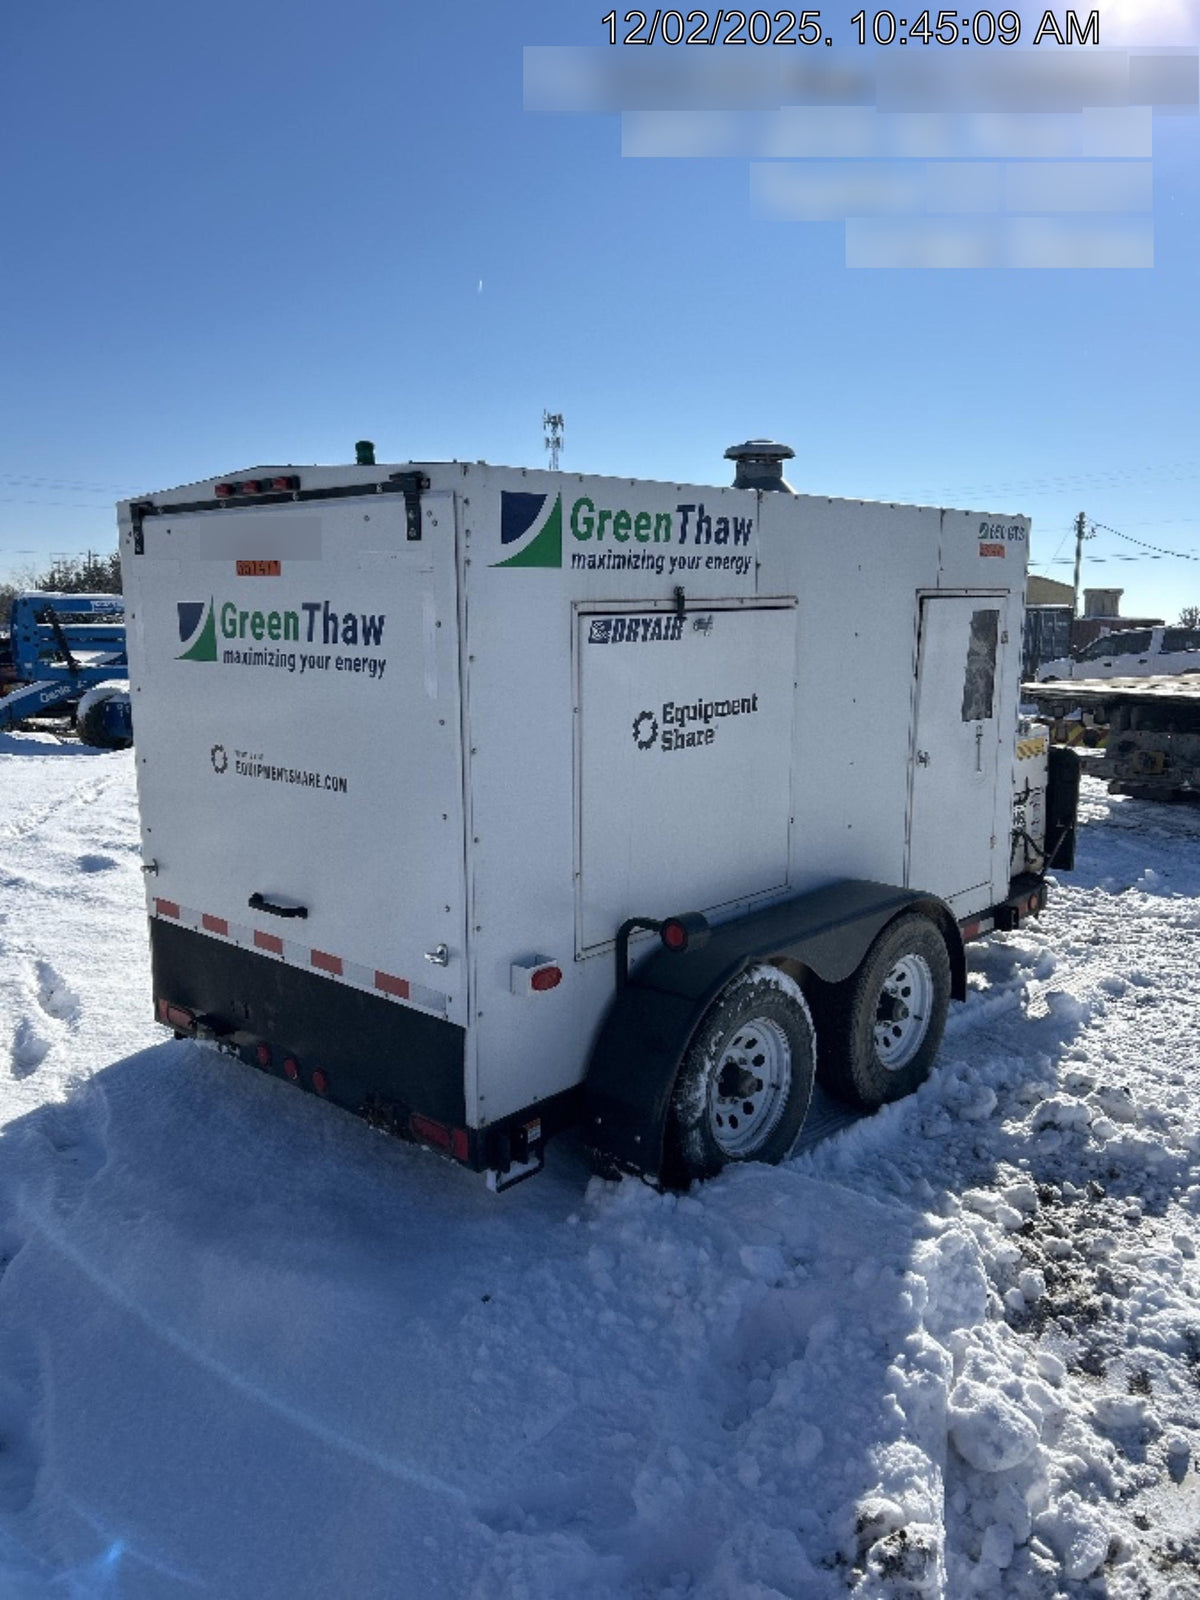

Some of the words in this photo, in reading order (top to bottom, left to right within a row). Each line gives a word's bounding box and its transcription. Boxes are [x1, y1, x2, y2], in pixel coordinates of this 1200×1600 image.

[570, 497, 753, 547] GreenThaw
[571, 549, 665, 575] maximizing
[668, 555, 702, 575] your
[705, 555, 752, 575] energy
[221, 600, 387, 646] GreenThaw
[223, 647, 296, 673] maximizing
[300, 653, 331, 674] your
[335, 656, 387, 680] energy
[662, 693, 758, 727] Equipment
[661, 728, 715, 752] Share
